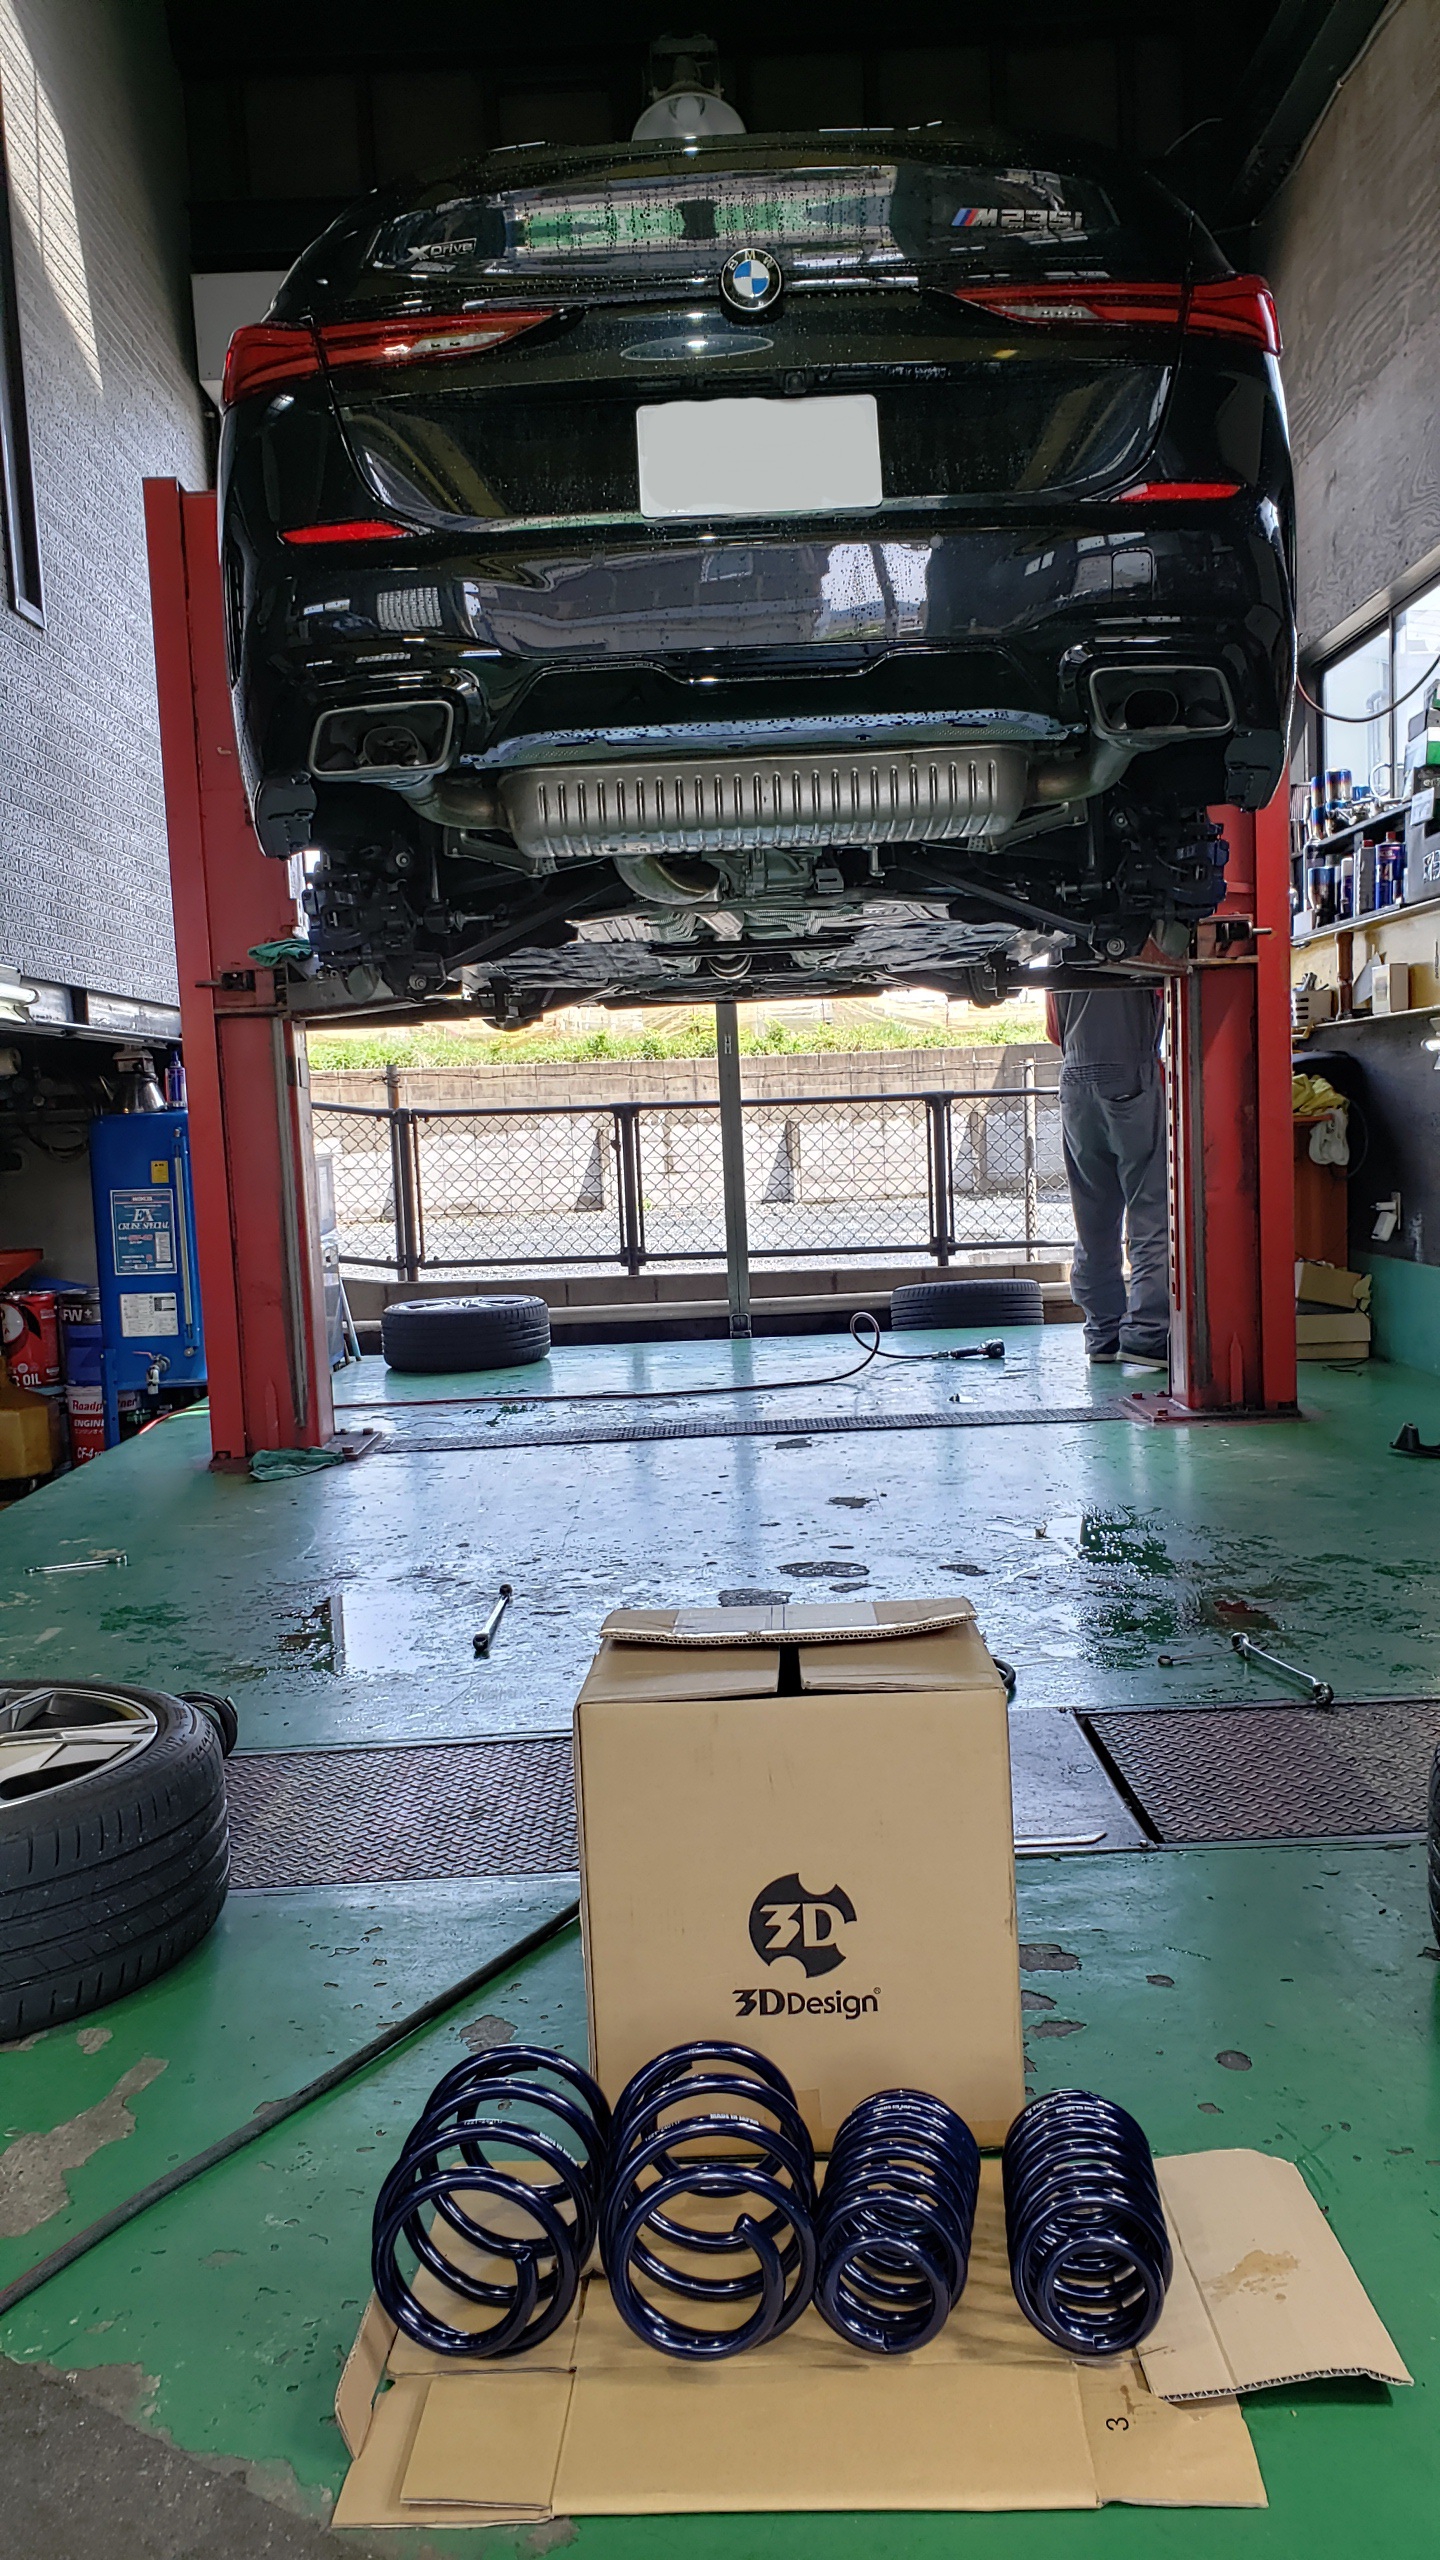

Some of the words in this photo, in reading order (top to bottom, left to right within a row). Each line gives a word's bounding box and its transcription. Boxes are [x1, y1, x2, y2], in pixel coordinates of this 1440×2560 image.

[971, 208, 1083, 229] M235i
[727, 249, 775, 271] BMW
[23, 1373, 42, 1386] OIL
[1106, 2417, 1129, 2431] 3
